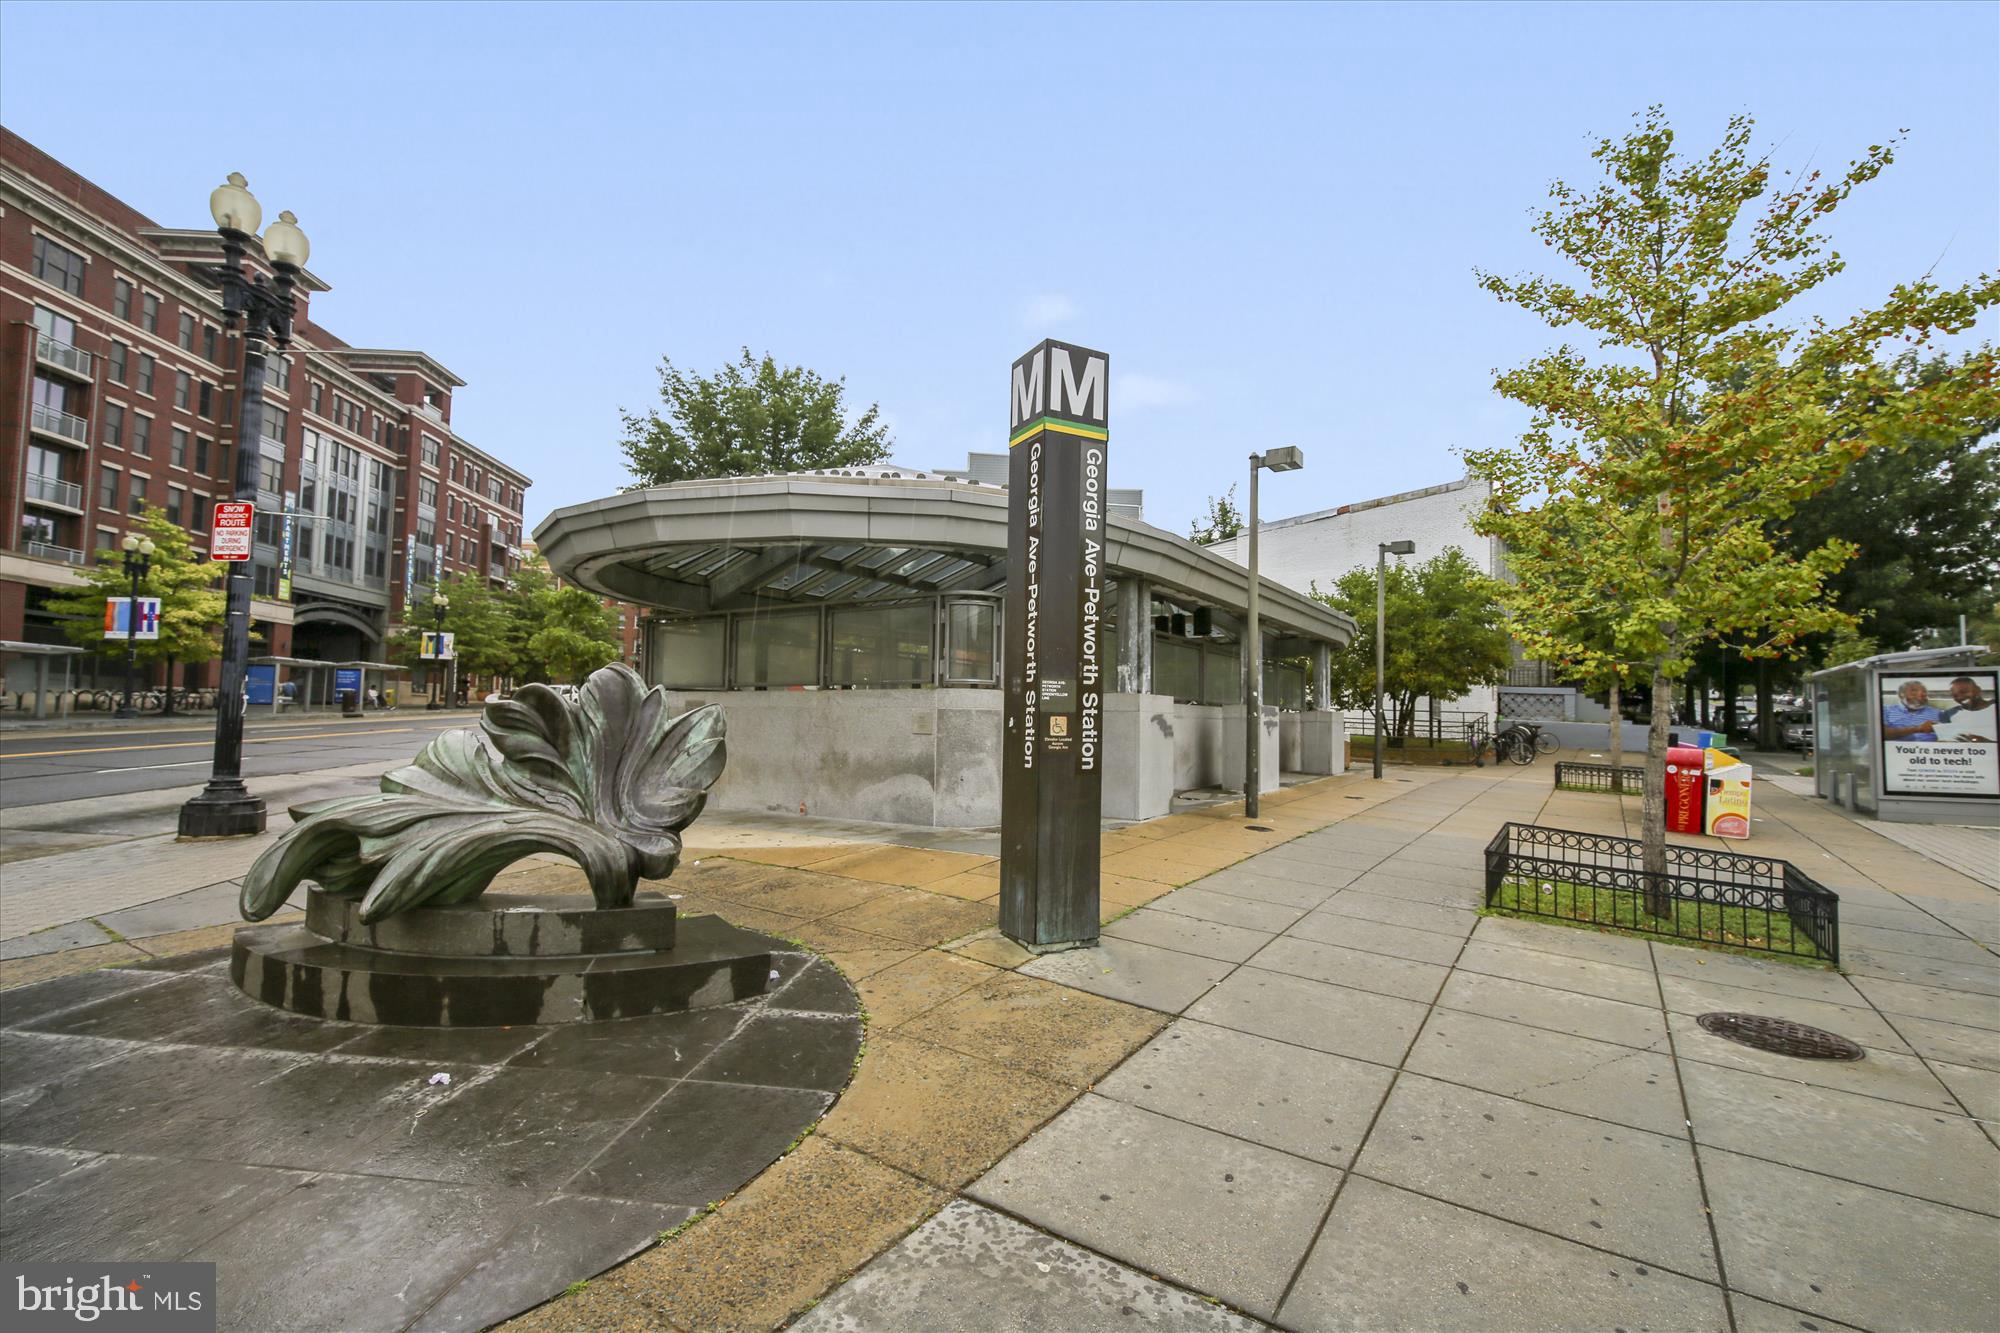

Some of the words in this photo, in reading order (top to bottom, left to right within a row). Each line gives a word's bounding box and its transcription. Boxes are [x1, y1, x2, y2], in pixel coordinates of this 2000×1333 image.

[1012, 349, 1044, 428] M
[1050, 347, 1105, 421] M
[223, 505, 246, 513] SNOW
[1028, 442, 1041, 527] Georgia
[1082, 448, 1103, 531] Georgia
[220, 519, 246, 527] ROUTE
[1024, 691, 1036, 768] Station
[1081, 692, 1098, 770] Station
[1895, 746, 1930, 754] You're
[1933, 747, 1964, 755] never
[1967, 747, 1986, 756] too
[1909, 756, 1926, 765] old
[1929, 757, 1941, 765] to
[1944, 757, 1973, 766] tech!
